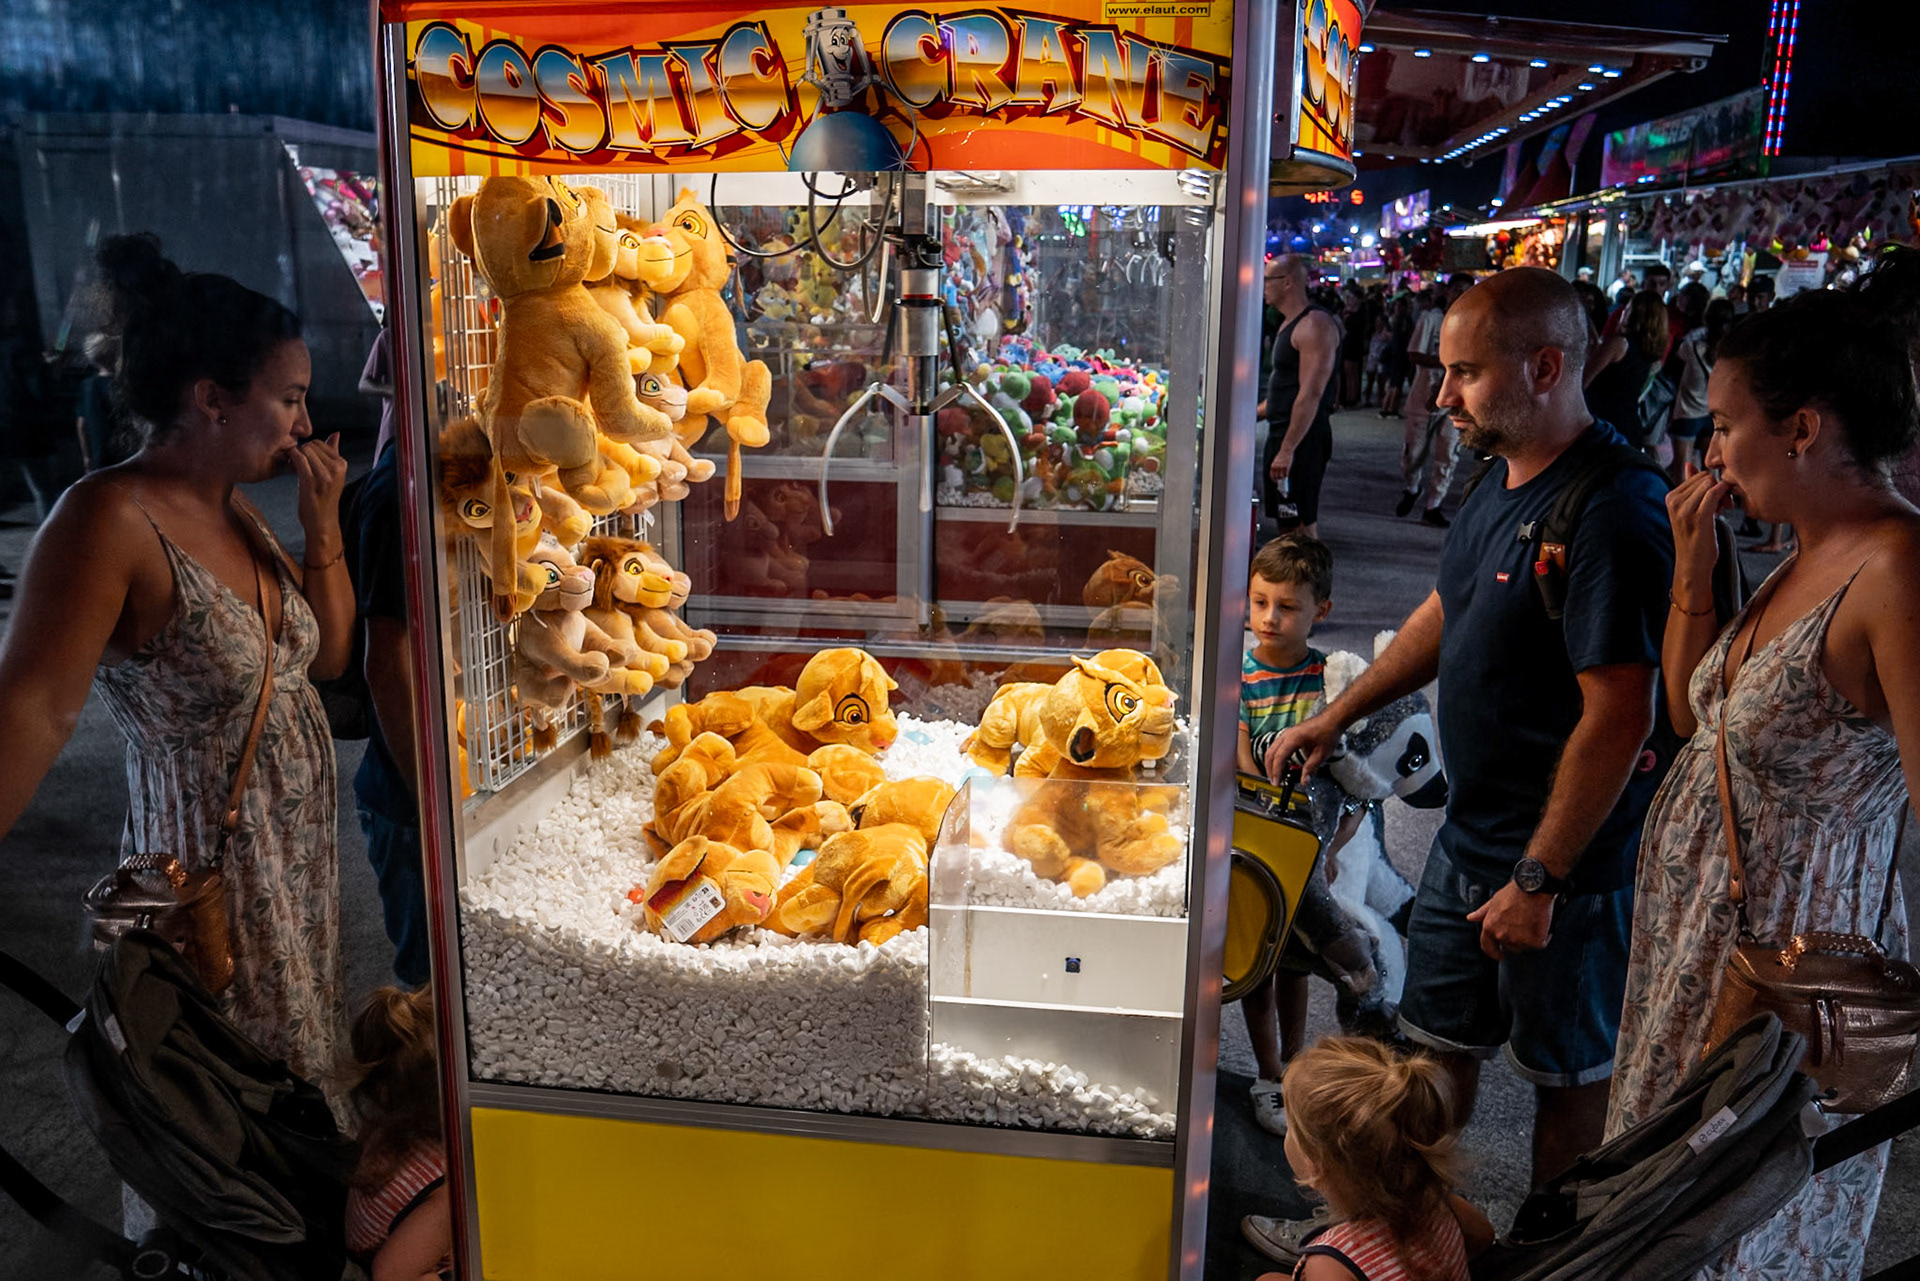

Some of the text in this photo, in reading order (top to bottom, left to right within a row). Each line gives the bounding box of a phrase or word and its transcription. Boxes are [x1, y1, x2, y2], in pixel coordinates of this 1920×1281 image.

[1108, 5, 1208, 15] www.elaut.com
[1308, 0, 1351, 142] COS
[415, 9, 1216, 158] COSMIC CRANE
